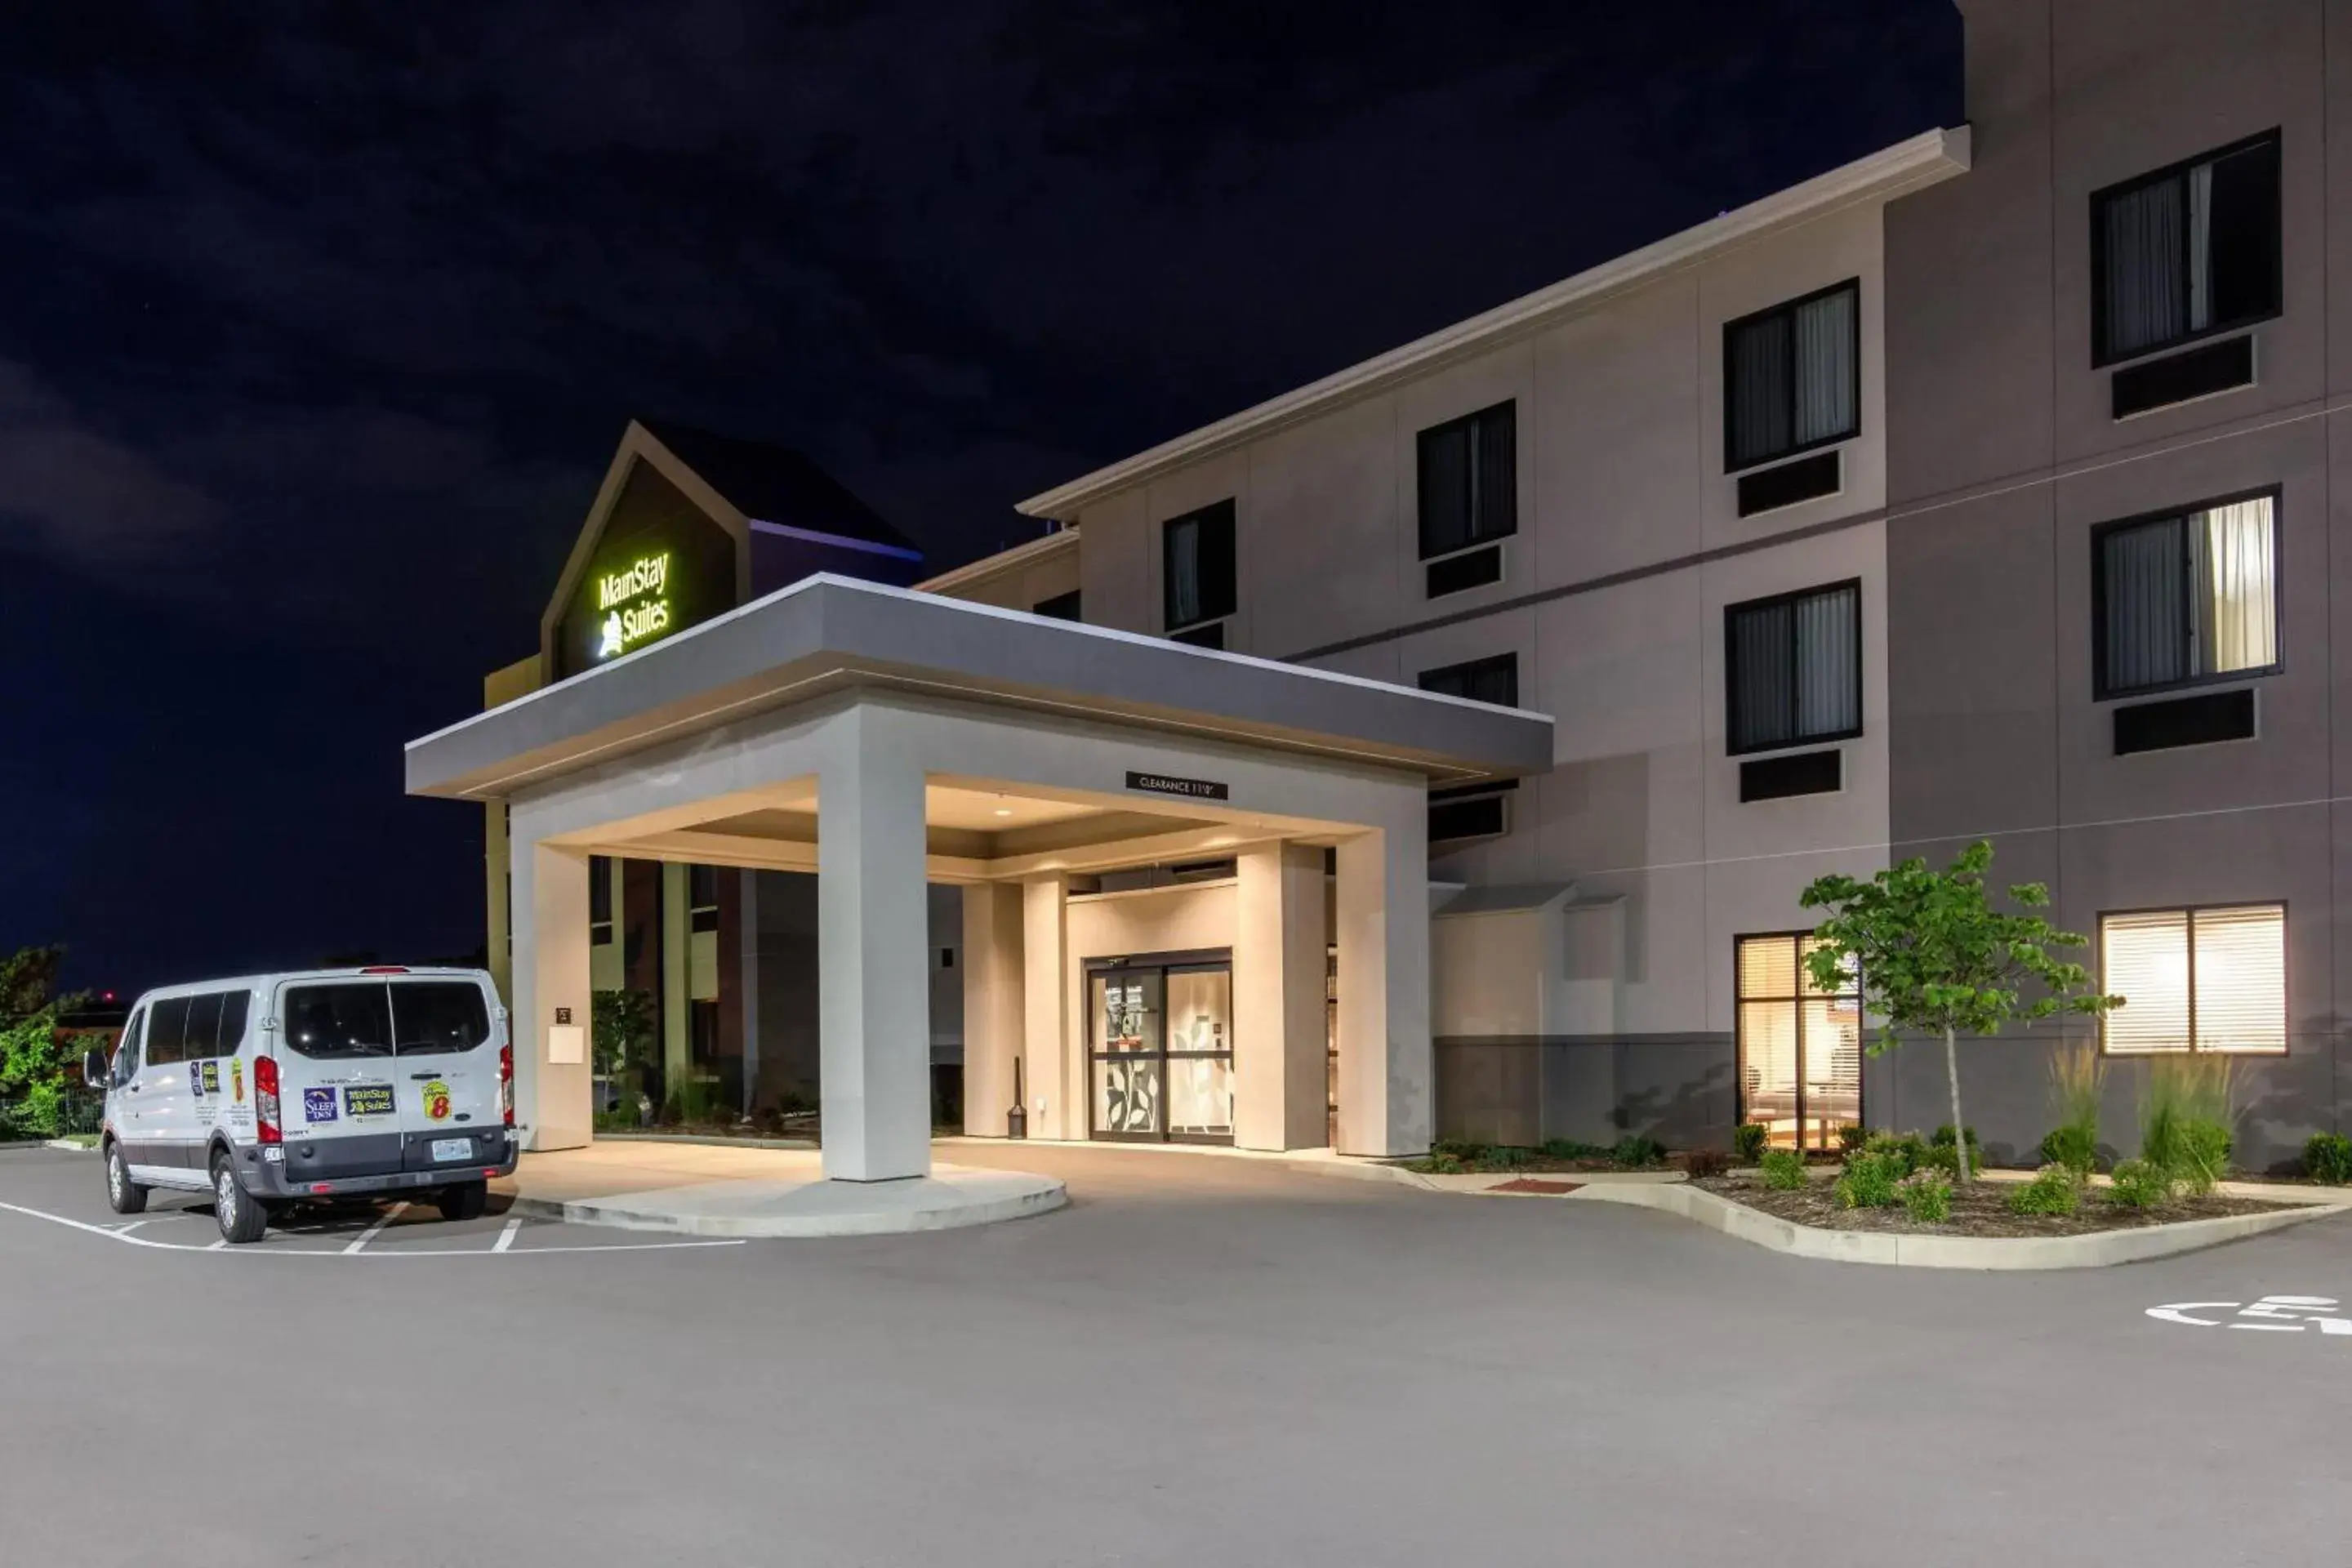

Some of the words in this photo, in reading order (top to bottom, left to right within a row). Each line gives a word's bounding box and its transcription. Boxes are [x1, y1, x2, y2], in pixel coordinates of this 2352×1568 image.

[599, 554, 668, 610] MainStay
[624, 599, 668, 642] Suites
[1139, 777, 1190, 792] CLEARANCE
[350, 1089, 390, 1102] MainStay
[305, 1099, 336, 1114] SLEEP
[314, 1111, 332, 1120] INN
